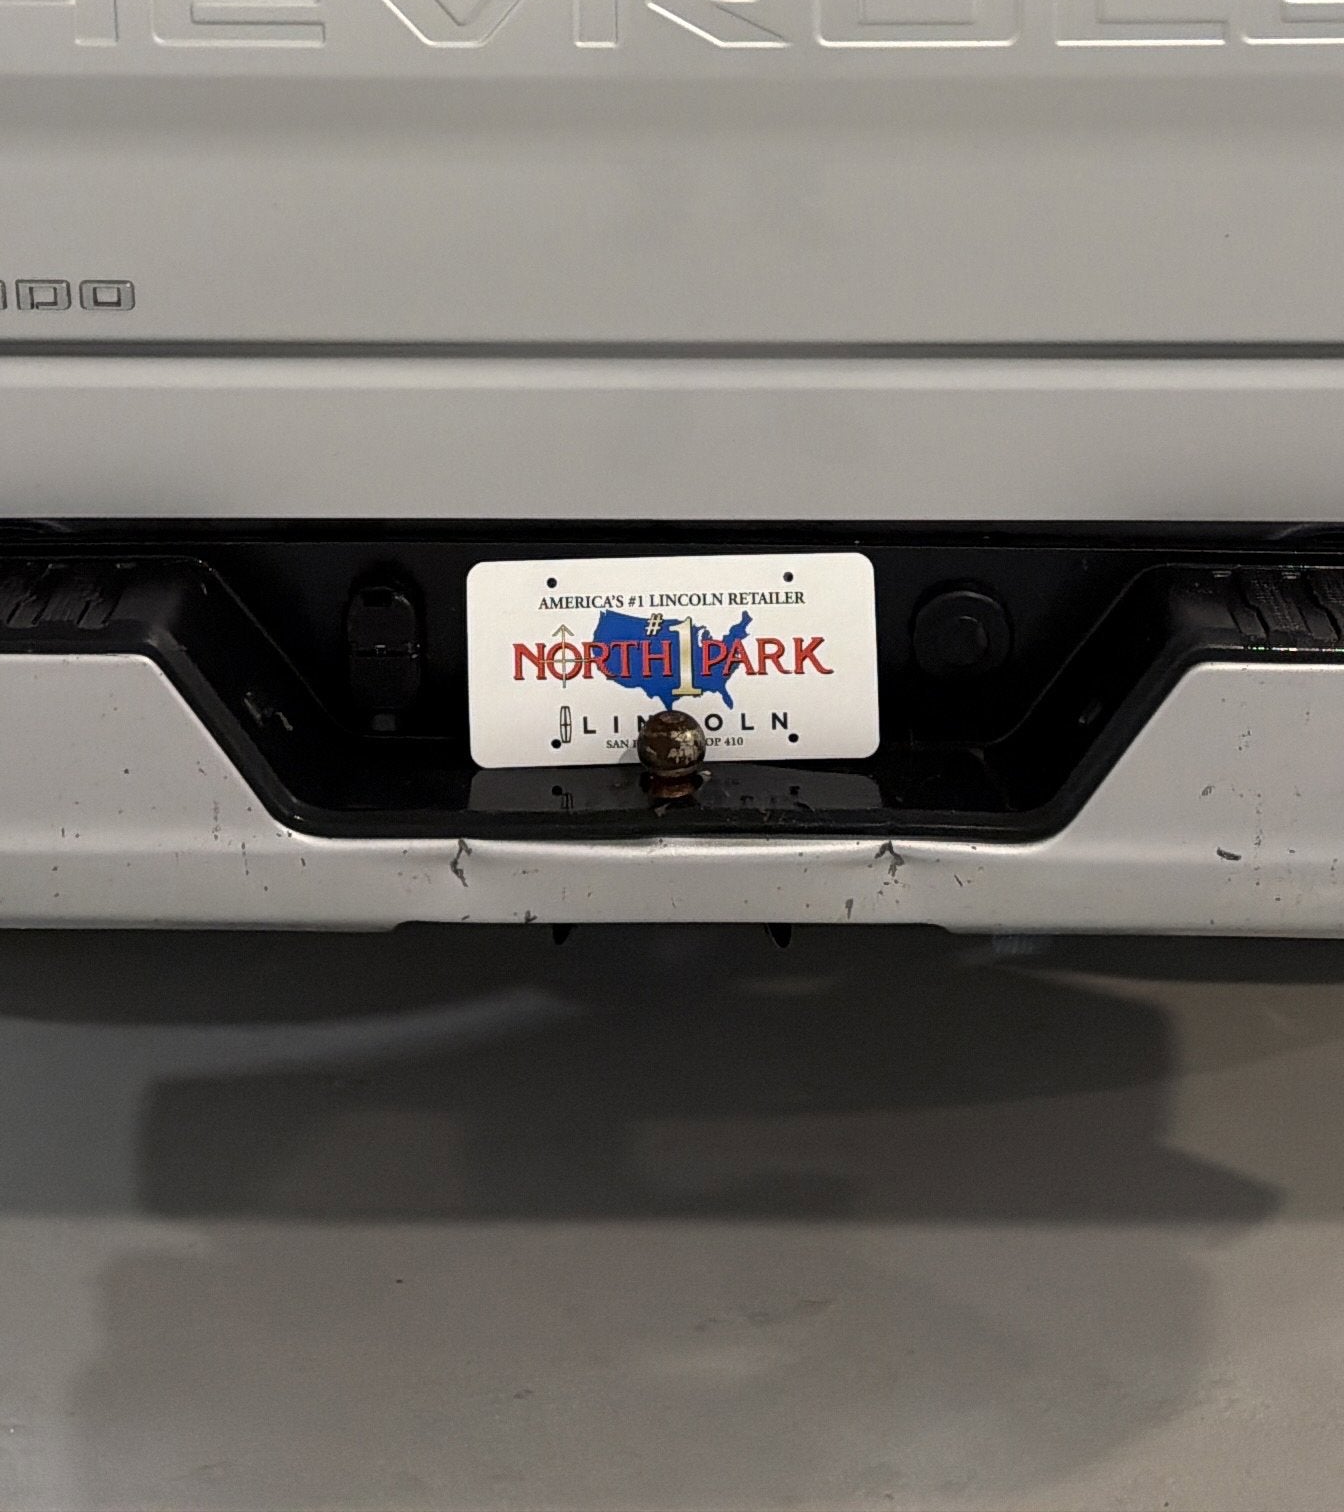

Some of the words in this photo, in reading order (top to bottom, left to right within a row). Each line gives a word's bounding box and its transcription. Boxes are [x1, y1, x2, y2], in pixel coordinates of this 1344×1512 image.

[538, 594, 624, 610] AMERICA'S
[627, 594, 644, 608] #1
[649, 592, 724, 607] LINCOLN
[728, 590, 806, 606] RETAILER
[512, 639, 672, 681] NORTH
[700, 636, 835, 676] PARK
[582, 711, 789, 735] LINOLN
[606, 738, 630, 749] SAN
[724, 736, 744, 747] 410
